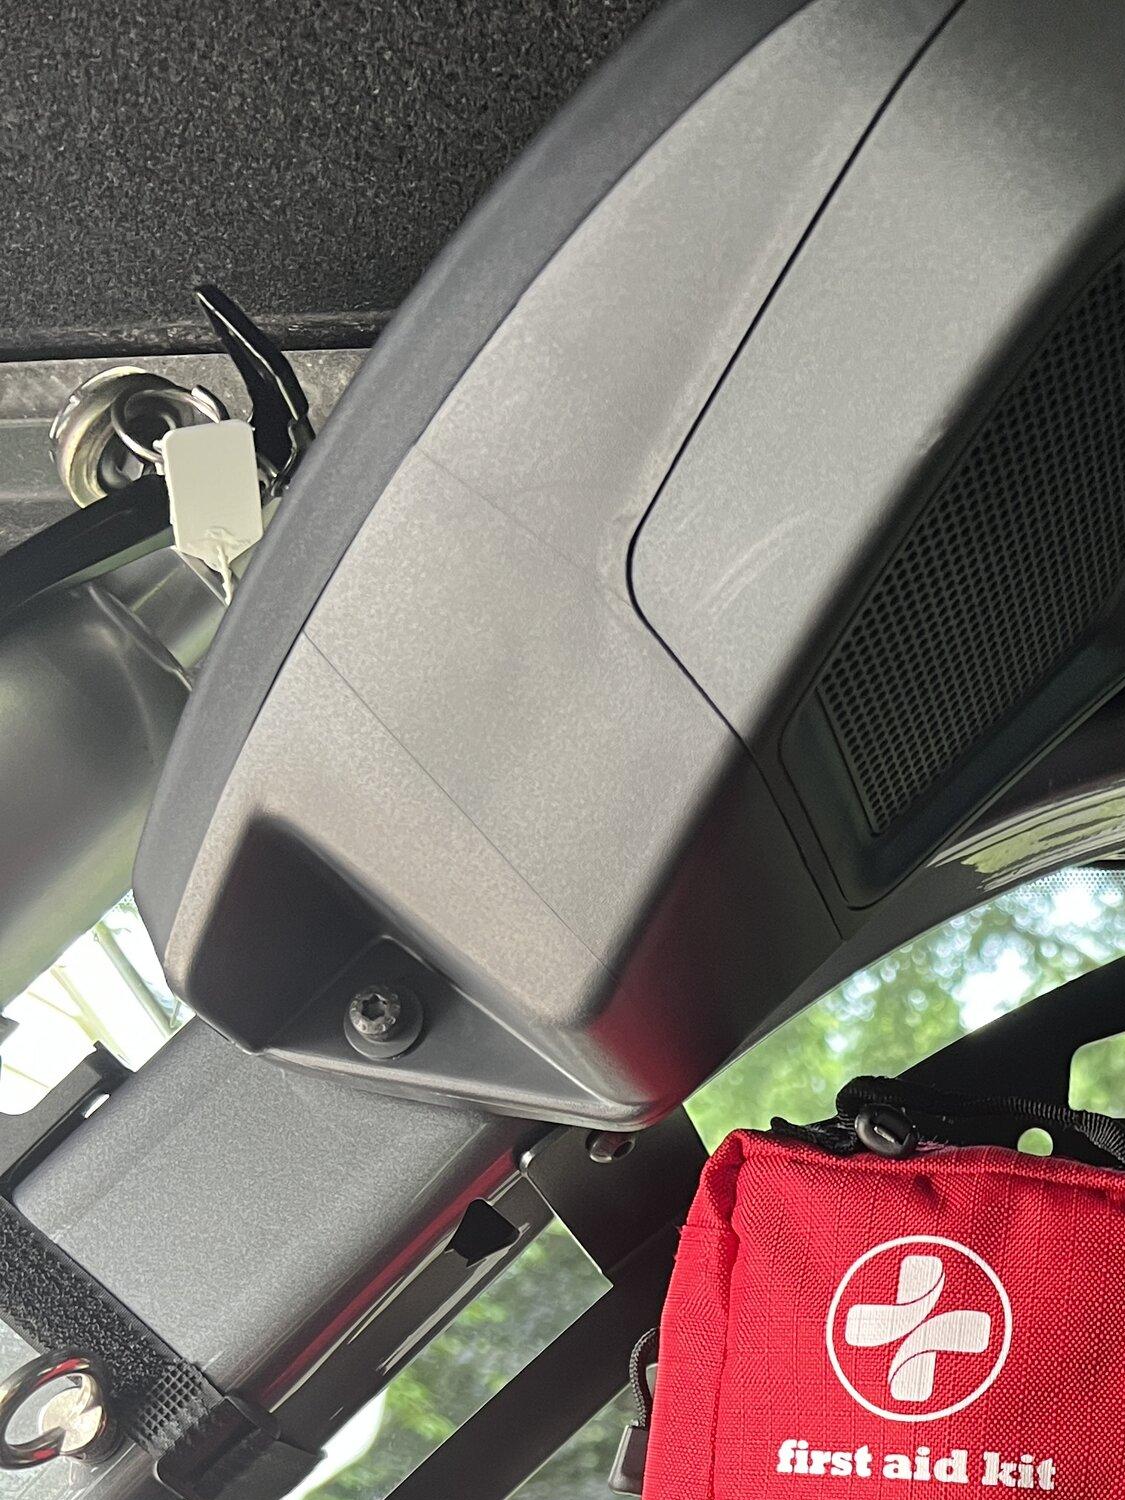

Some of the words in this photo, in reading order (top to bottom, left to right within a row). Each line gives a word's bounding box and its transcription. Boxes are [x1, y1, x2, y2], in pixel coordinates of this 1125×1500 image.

[775, 1438, 873, 1479] first
[882, 1445, 970, 1485] aid
[981, 1450, 1057, 1491] kit
